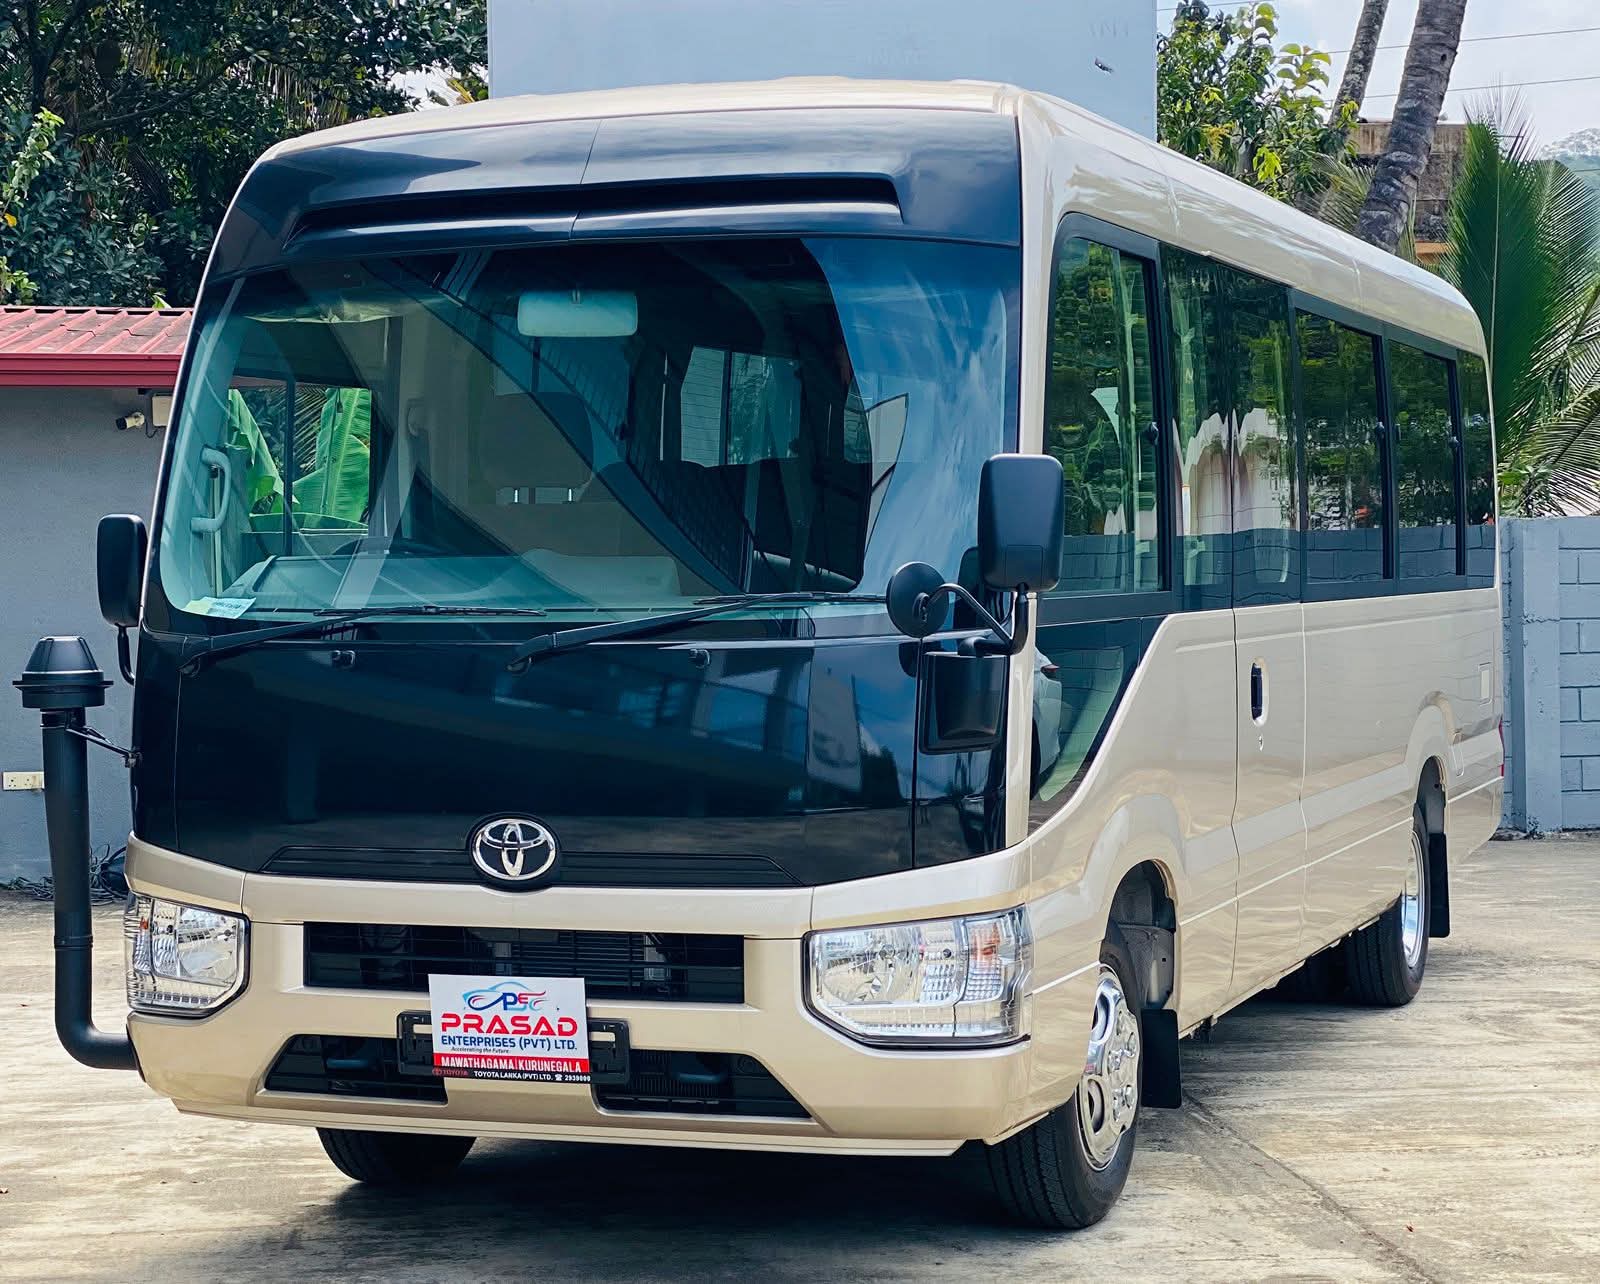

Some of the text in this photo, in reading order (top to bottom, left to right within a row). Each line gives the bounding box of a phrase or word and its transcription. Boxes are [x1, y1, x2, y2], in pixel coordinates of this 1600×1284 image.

[441, 1013, 578, 1037] PRASAD
[441, 1035, 578, 1052] ENTERPRISES (PVT) LTD.
[441, 1056, 582, 1073] MAWATHAGAMA KURUNEGALA
[473, 1070, 499, 1078] TOYOTA
[501, 1071, 522, 1079] LANKA
